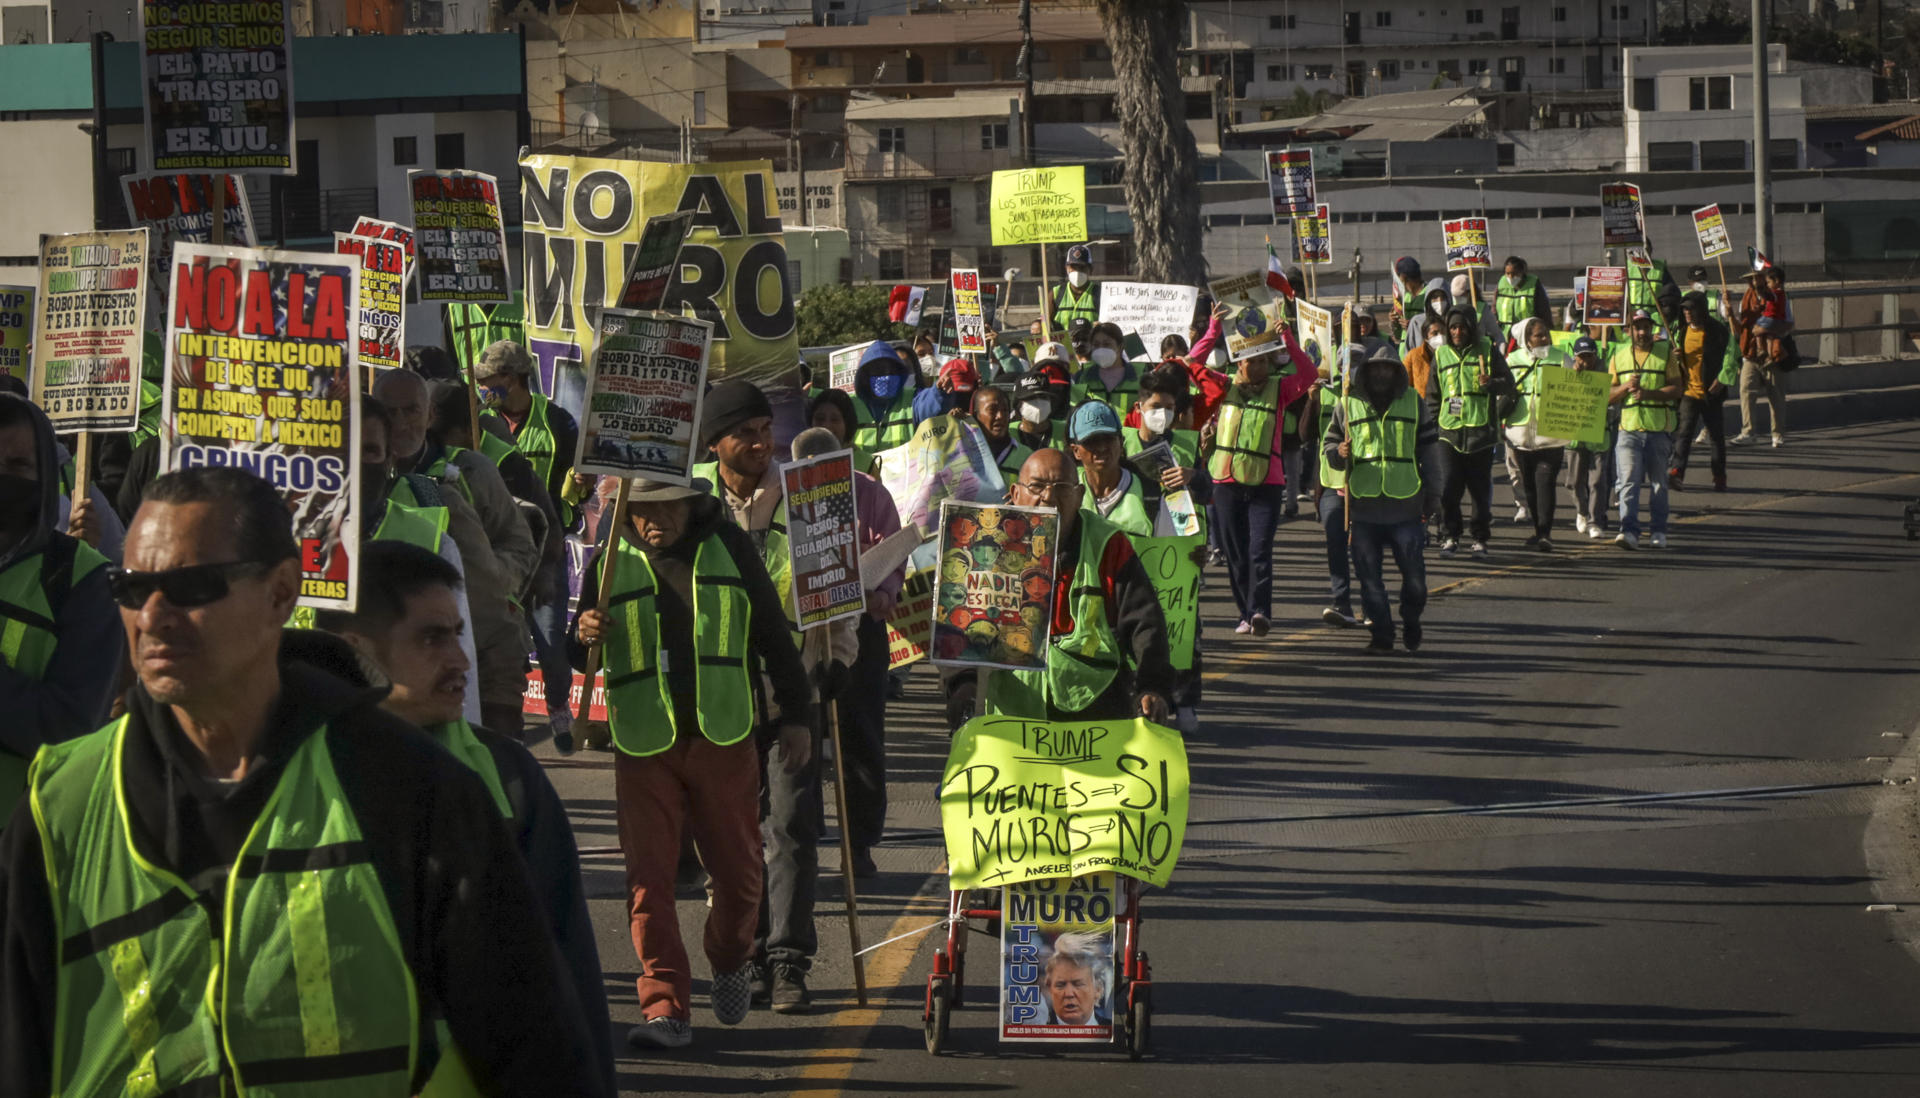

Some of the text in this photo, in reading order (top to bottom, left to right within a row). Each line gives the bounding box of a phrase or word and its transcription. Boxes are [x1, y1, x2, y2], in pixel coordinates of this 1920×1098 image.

[144, 2, 283, 26] NO QUEREMOS
[146, 26, 284, 49] SEGUIR SIENDO
[159, 51, 276, 75] EL PATIO
[158, 79, 279, 102] TRASERO
[208, 107, 232, 122] DE
[156, 155, 289, 168] ANGELES SIN FRONTERAS
[1002, 170, 1056, 190] TRUMP
[128, 176, 174, 221] NO
[520, 165, 783, 238] NO AL
[1020, 193, 1074, 207] MIGRANTES
[415, 201, 498, 217] NO QUEREMOS
[152, 208, 242, 234] TROMISON
[416, 215, 500, 229] SEGUIR SIENDO
[1002, 225, 1024, 240] NO
[1027, 222, 1081, 236] CRIMINALES
[424, 231, 496, 244] EL PATIO
[71, 245, 109, 268] TRATADO
[366, 245, 377, 269] A
[383, 247, 402, 274] LA
[424, 247, 498, 260] TRASERO
[455, 263, 470, 273] DE
[47, 293, 136, 313] ROBO DE NUESTRO
[175, 263, 348, 340] NO A LA
[1125, 287, 1178, 300] MEJOR MURO
[46, 309, 135, 330] TERRITORIO
[360, 309, 399, 328] INGOS
[179, 333, 342, 368] INTERVENCION
[601, 352, 699, 372] ROBO DE NUESTRO
[205, 361, 312, 392] DE LOS EE. UU.
[600, 364, 697, 384] TERRITORIO
[43, 386, 130, 399] QUE NOS DEVUELVAN
[44, 397, 128, 413] LO ROBADO
[178, 387, 342, 422] EN ASUNTOS QUE SOLO
[177, 412, 342, 448] COMPETEN A MEXICO
[602, 420, 619, 429] LO
[621, 421, 673, 435] ROBADO
[921, 425, 947, 441] MURO
[967, 573, 1022, 595] NADIE
[967, 592, 982, 605] ES
[984, 720, 1109, 761] TRUMP
[947, 754, 1168, 818] PUENTES SI
[972, 811, 1172, 871] MUROS NO
[1025, 864, 1071, 877] ANGELES
[1069, 875, 1110, 893] AL
[1009, 894, 1111, 924] MURO
[1008, 925, 1040, 1024] TRUMP
